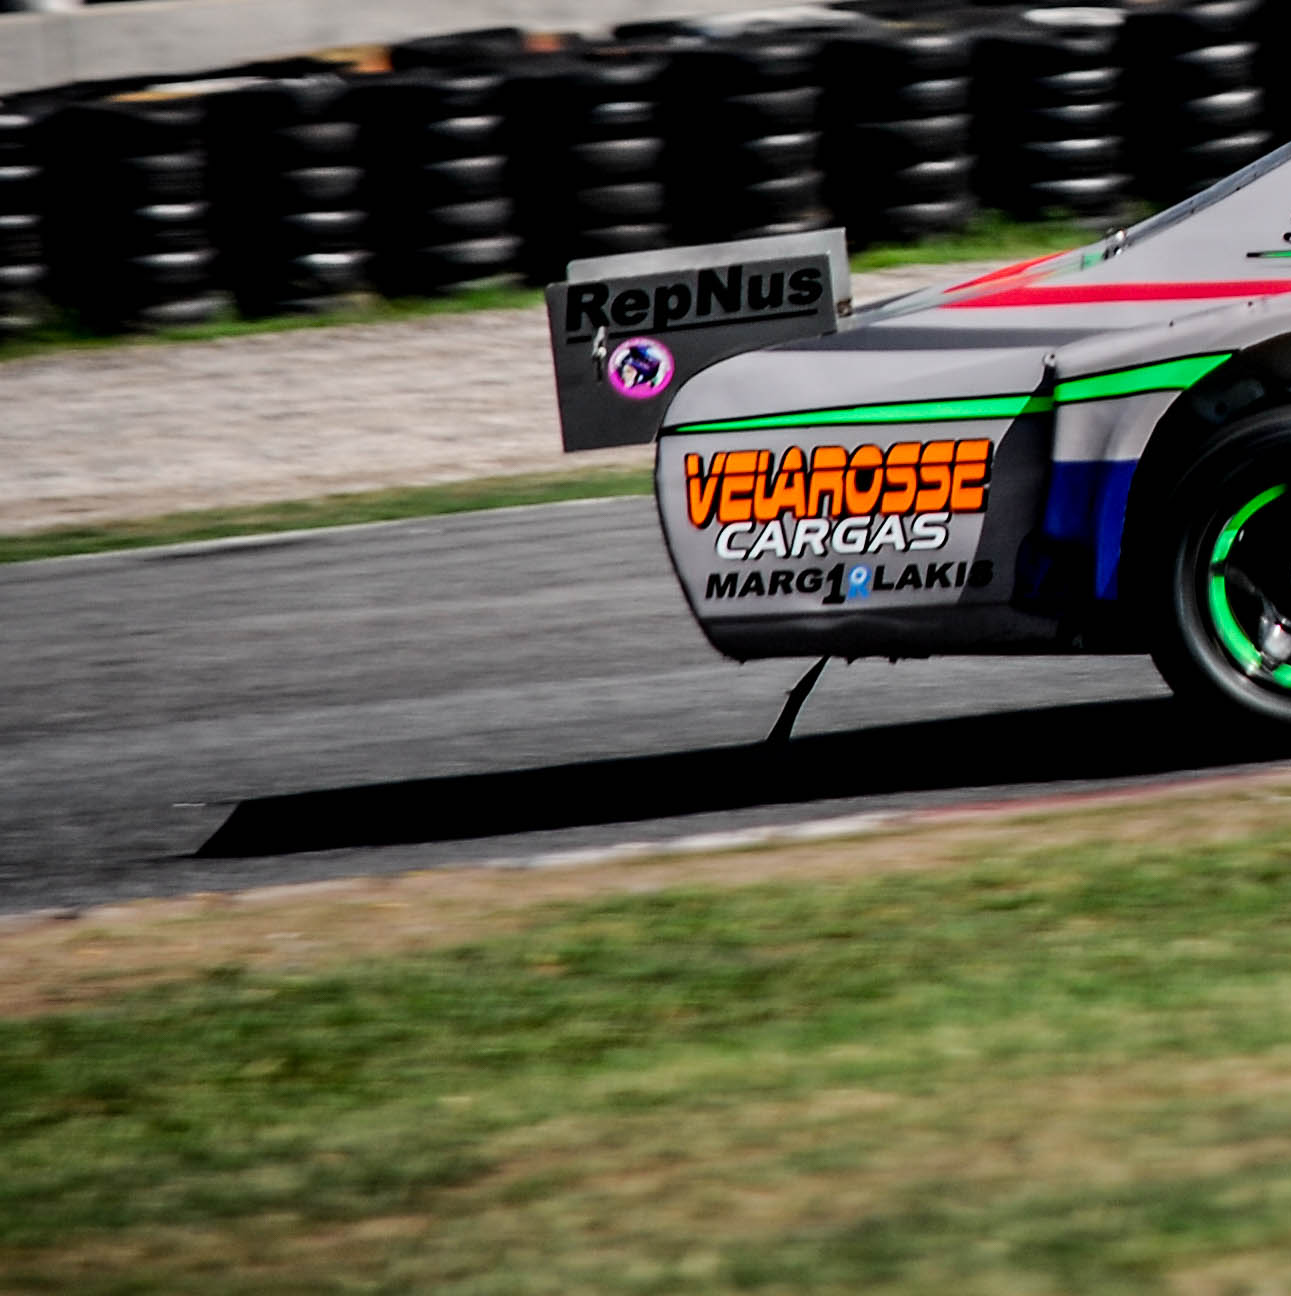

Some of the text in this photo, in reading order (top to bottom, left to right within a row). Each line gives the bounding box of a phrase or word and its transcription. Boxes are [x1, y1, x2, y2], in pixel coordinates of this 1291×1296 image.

[566, 265, 823, 331] RepNus
[685, 438, 994, 528] VELAROSSE
[716, 513, 950, 560] CARGAS
